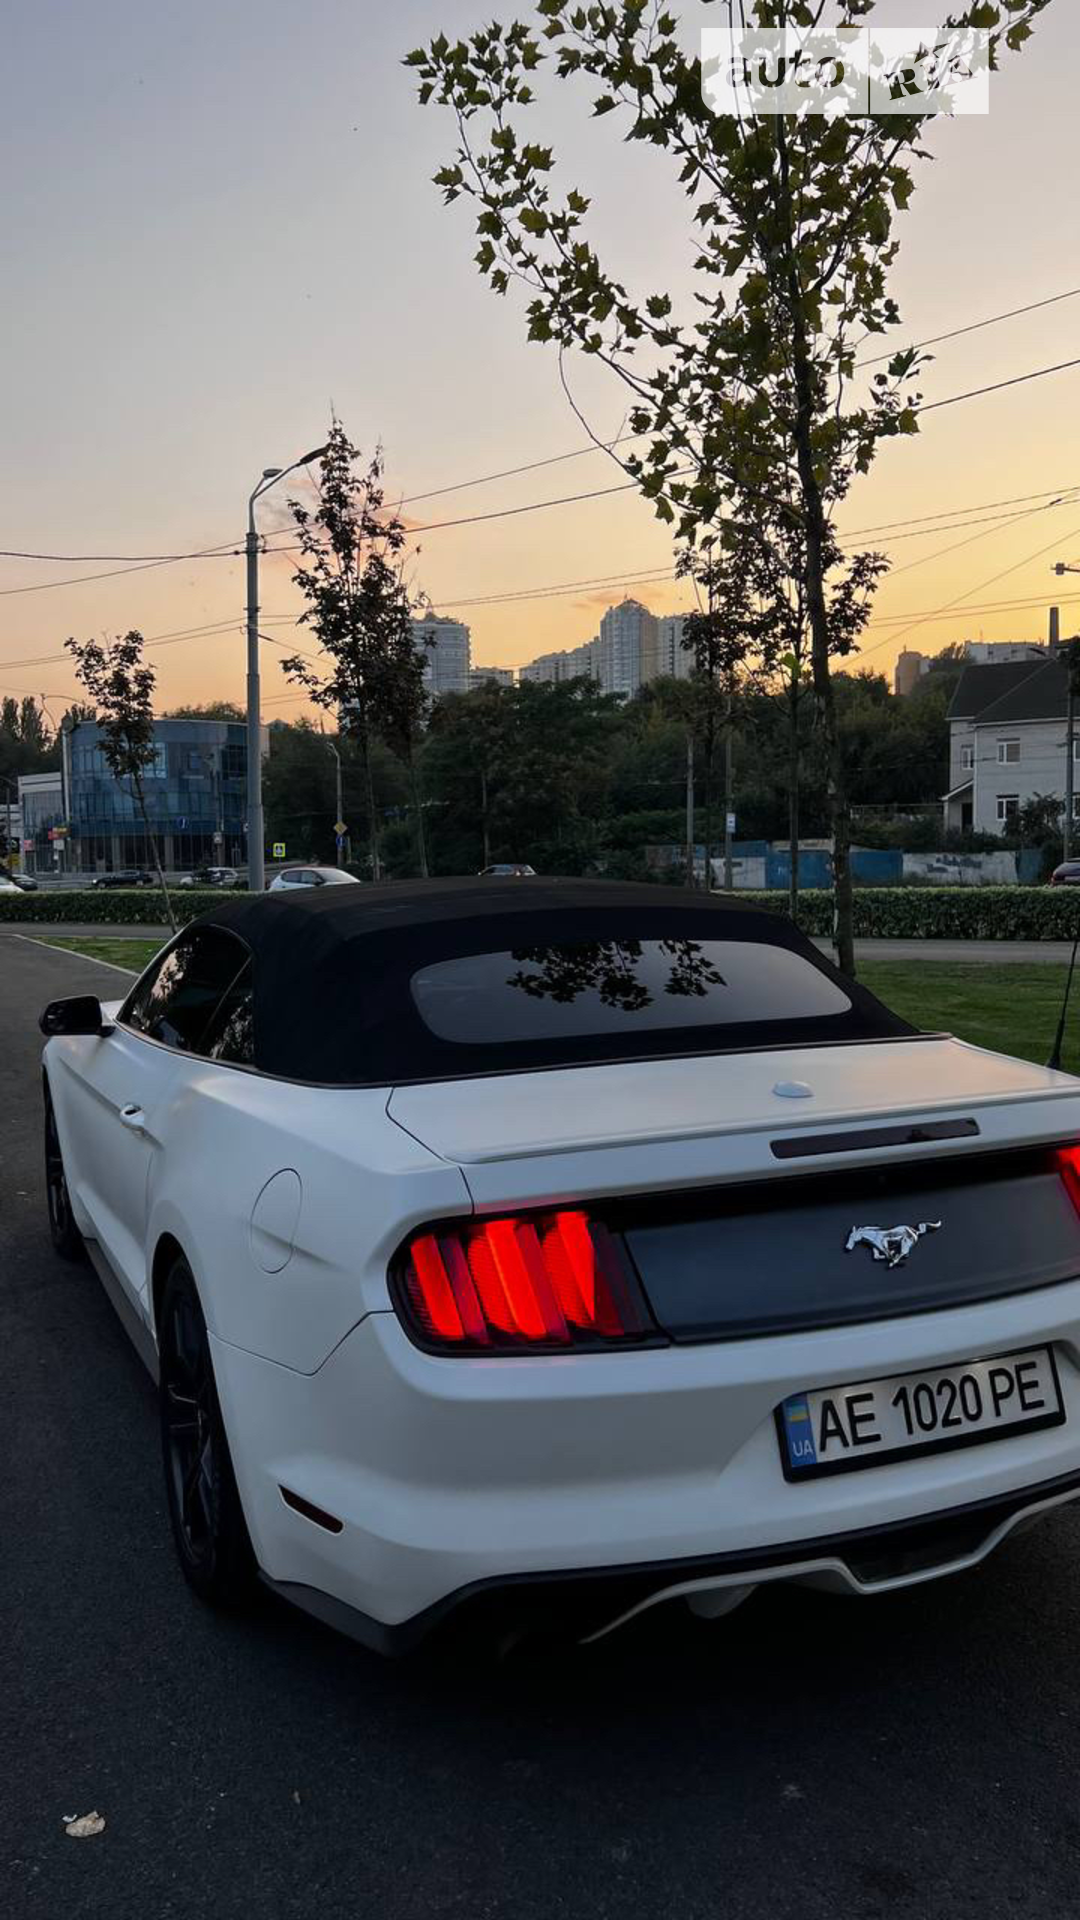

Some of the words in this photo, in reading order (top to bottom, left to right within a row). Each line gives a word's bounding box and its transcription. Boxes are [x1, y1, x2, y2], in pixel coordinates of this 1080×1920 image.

[819, 1392, 882, 1452] AE
[892, 1375, 983, 1435] 1020
[989, 1361, 1045, 1417] PE
[792, 1440, 814, 1457] UA
